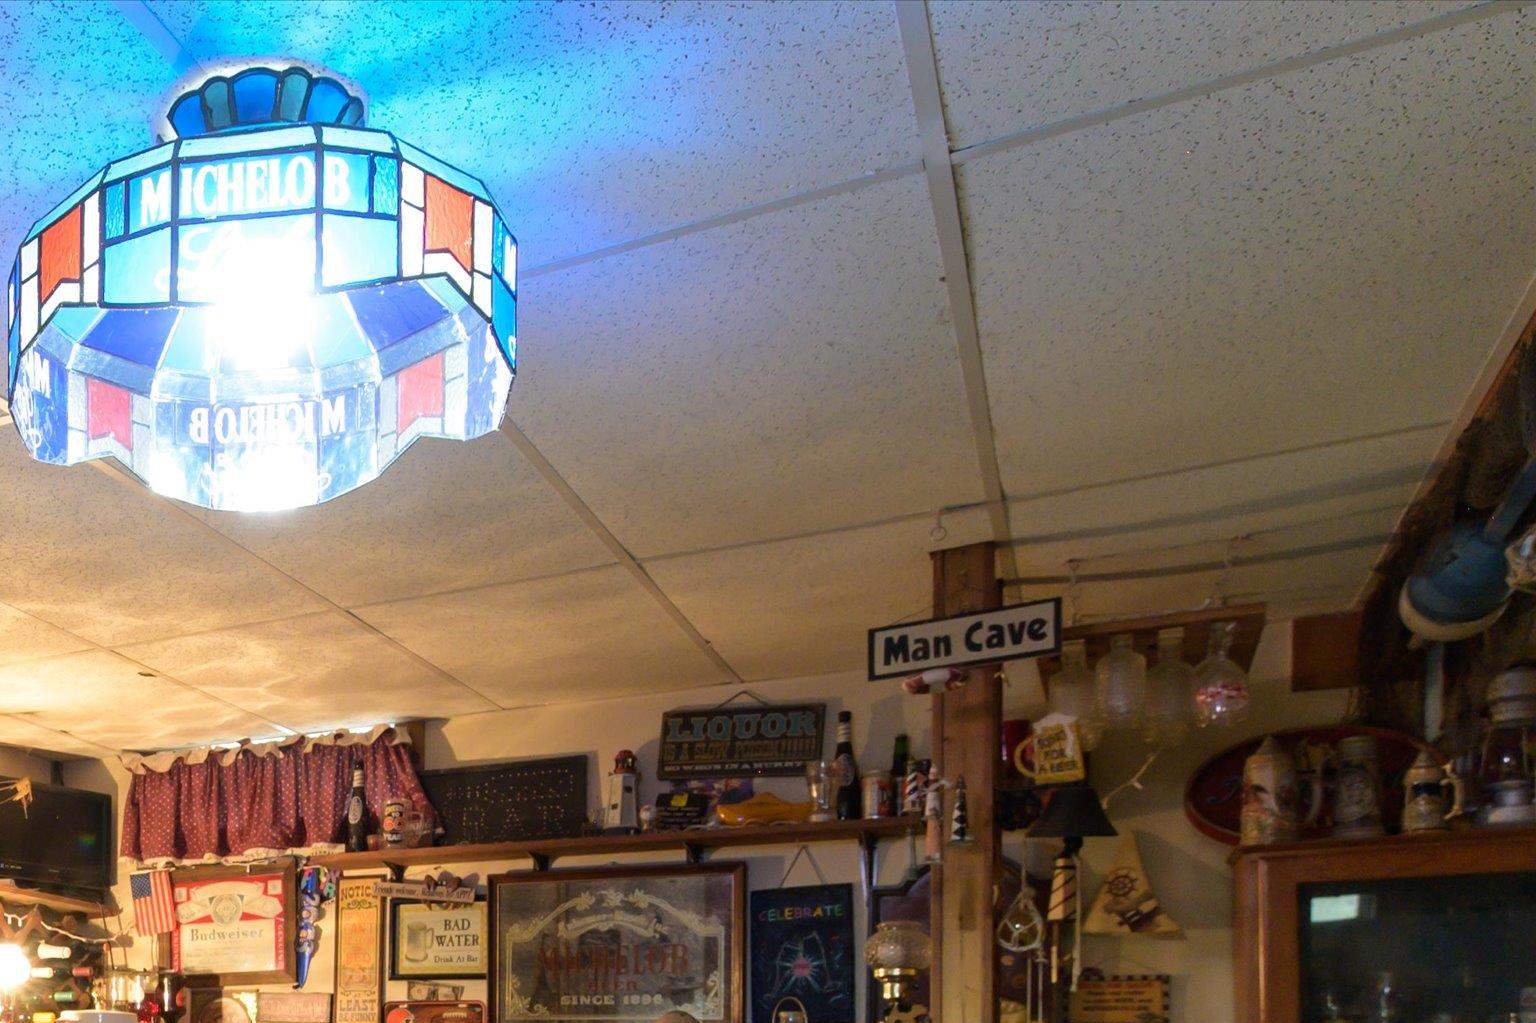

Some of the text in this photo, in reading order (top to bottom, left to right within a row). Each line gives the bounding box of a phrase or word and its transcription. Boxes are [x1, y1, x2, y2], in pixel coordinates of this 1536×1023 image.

[139, 154, 352, 228] MICHELOB
[883, 617, 1048, 666] Man Cave
[666, 710, 817, 742] LIQUOR
[340, 884, 378, 901] NOTIC
[757, 904, 843, 922] CELEBRATE
[444, 918, 471, 931] BAD
[190, 928, 265, 942] Budweiser
[435, 934, 480, 947] WATER
[434, 955, 453, 963] Drink
[467, 954, 478, 963] Bar
[339, 998, 376, 1012] LEAST
[561, 994, 615, 1005] SINCE
